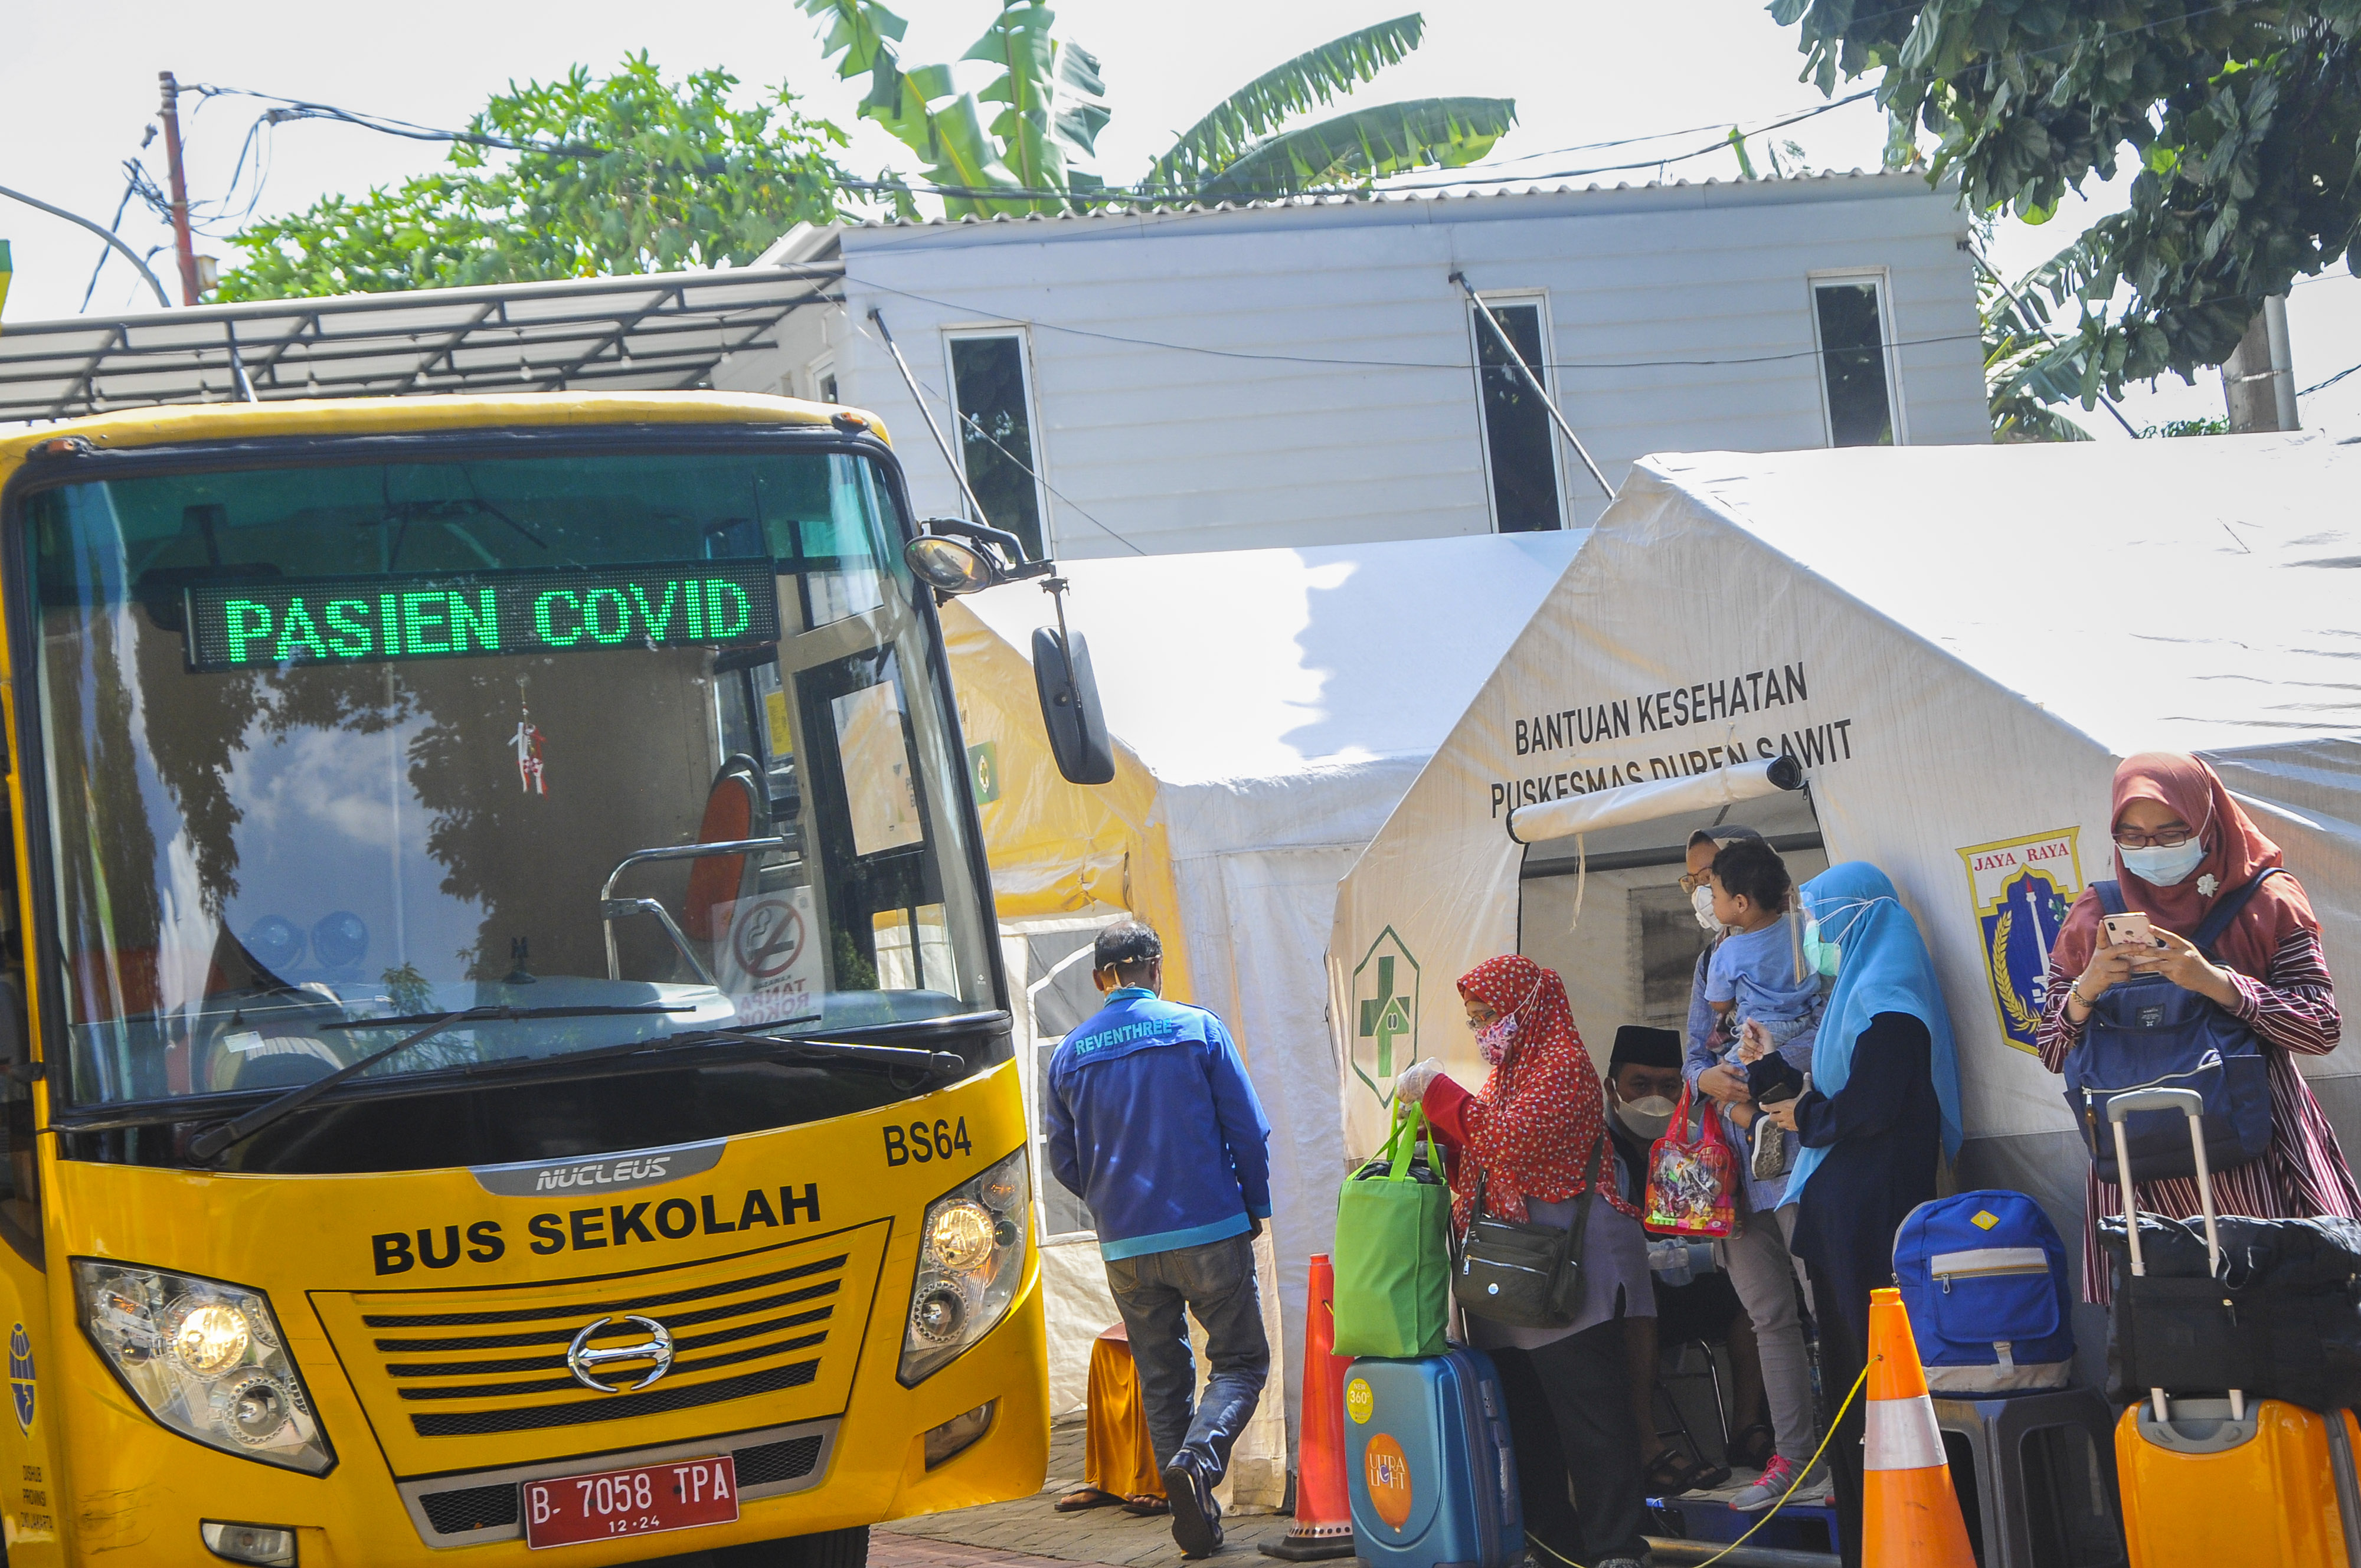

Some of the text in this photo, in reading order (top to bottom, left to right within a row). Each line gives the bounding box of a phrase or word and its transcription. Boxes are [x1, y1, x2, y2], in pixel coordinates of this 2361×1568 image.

[225, 578, 751, 663] PASIEN COVID
[1515, 661, 1808, 756] BANTUAN KESEHATAN
[1974, 843, 2069, 872] JAYA RAYA
[1075, 1017, 1173, 1055] REVENTHREE
[882, 1115, 972, 1167] BS64
[535, 1156, 671, 1191] NUCLEUS
[371, 1183, 821, 1276] BUS SEKOLAH
[1369, 1453, 1405, 1472] ULTRA
[1371, 1465, 1405, 1490] LIGHT
[576, 1473, 652, 1518] 7058
[673, 1463, 730, 1504] TPA
